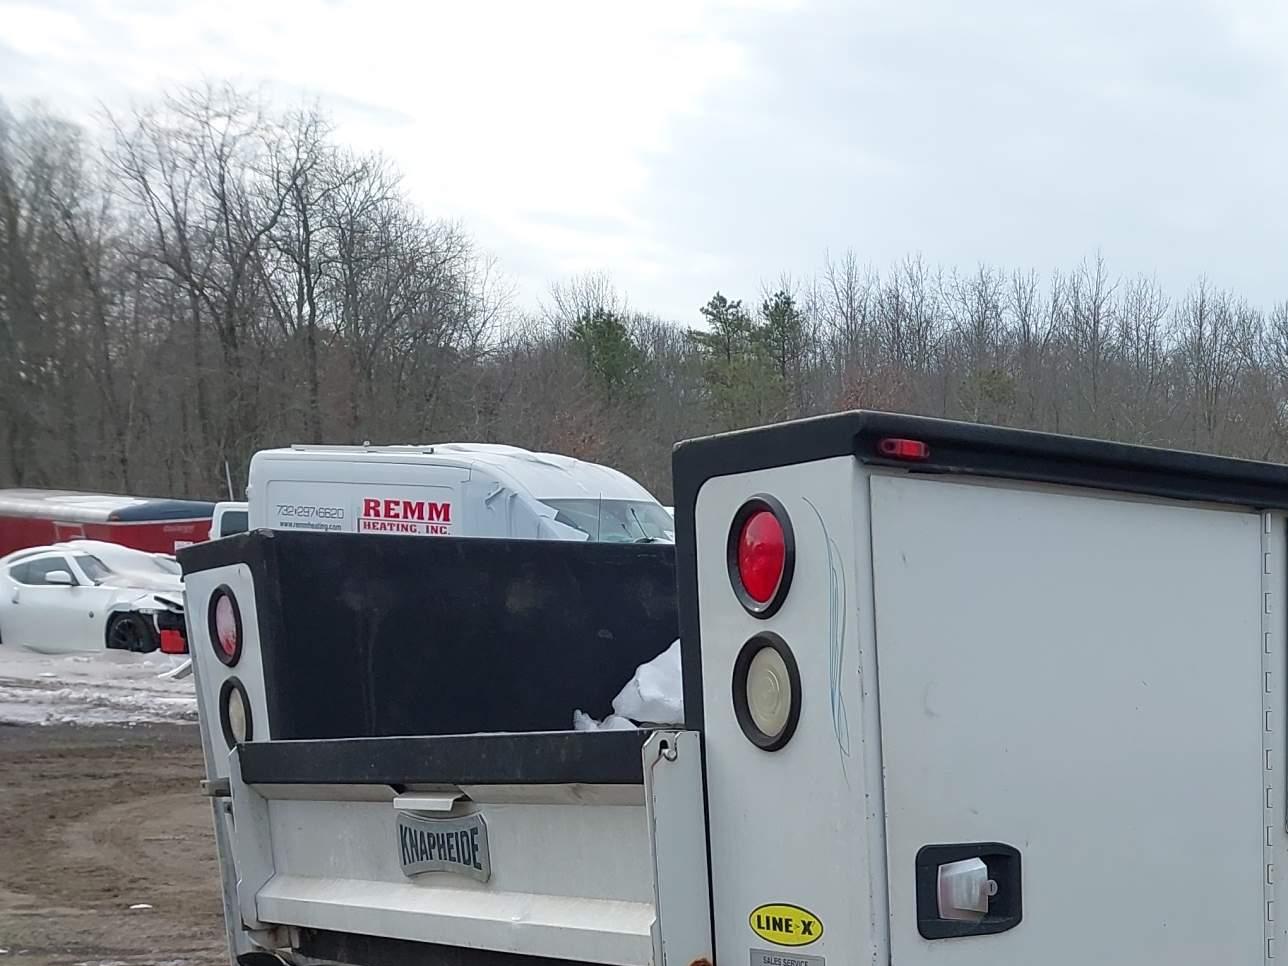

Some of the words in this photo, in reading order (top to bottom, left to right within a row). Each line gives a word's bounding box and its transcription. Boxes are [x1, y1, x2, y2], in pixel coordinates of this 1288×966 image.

[363, 498, 451, 522] REMM
[425, 525, 451, 536] INC.
[400, 824, 482, 870] KNAPHEIDE
[763, 956, 781, 966] SALES
